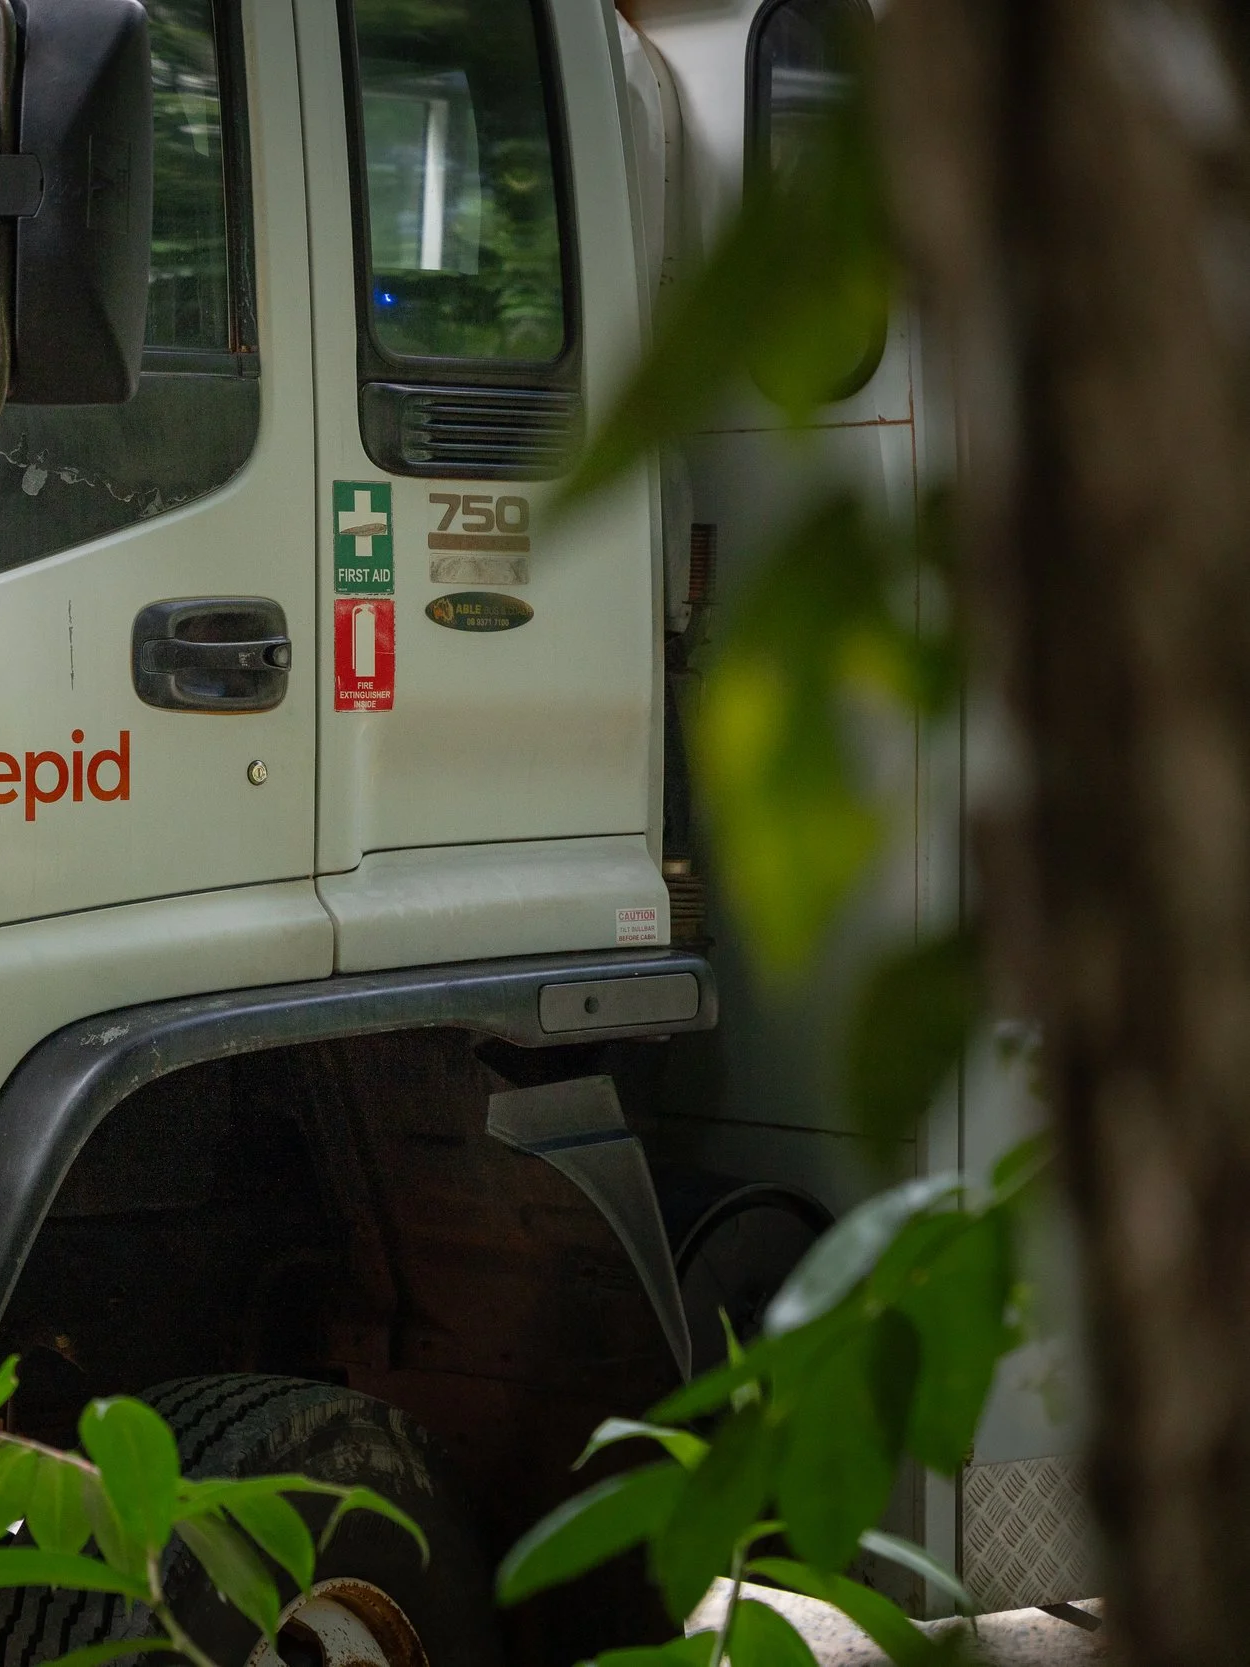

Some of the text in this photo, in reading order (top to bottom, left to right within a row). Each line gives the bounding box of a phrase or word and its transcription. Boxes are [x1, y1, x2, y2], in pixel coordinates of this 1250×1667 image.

[429, 493, 530, 533] 750
[338, 568, 391, 583] FIRST AID
[456, 603, 482, 615] ABLE
[357, 681, 374, 690] FIRE
[339, 690, 391, 699] EXTINGUISHER
[353, 700, 377, 709] INSIDE
[618, 910, 655, 921] CAUTION
[618, 934, 640, 942] BEFORE
